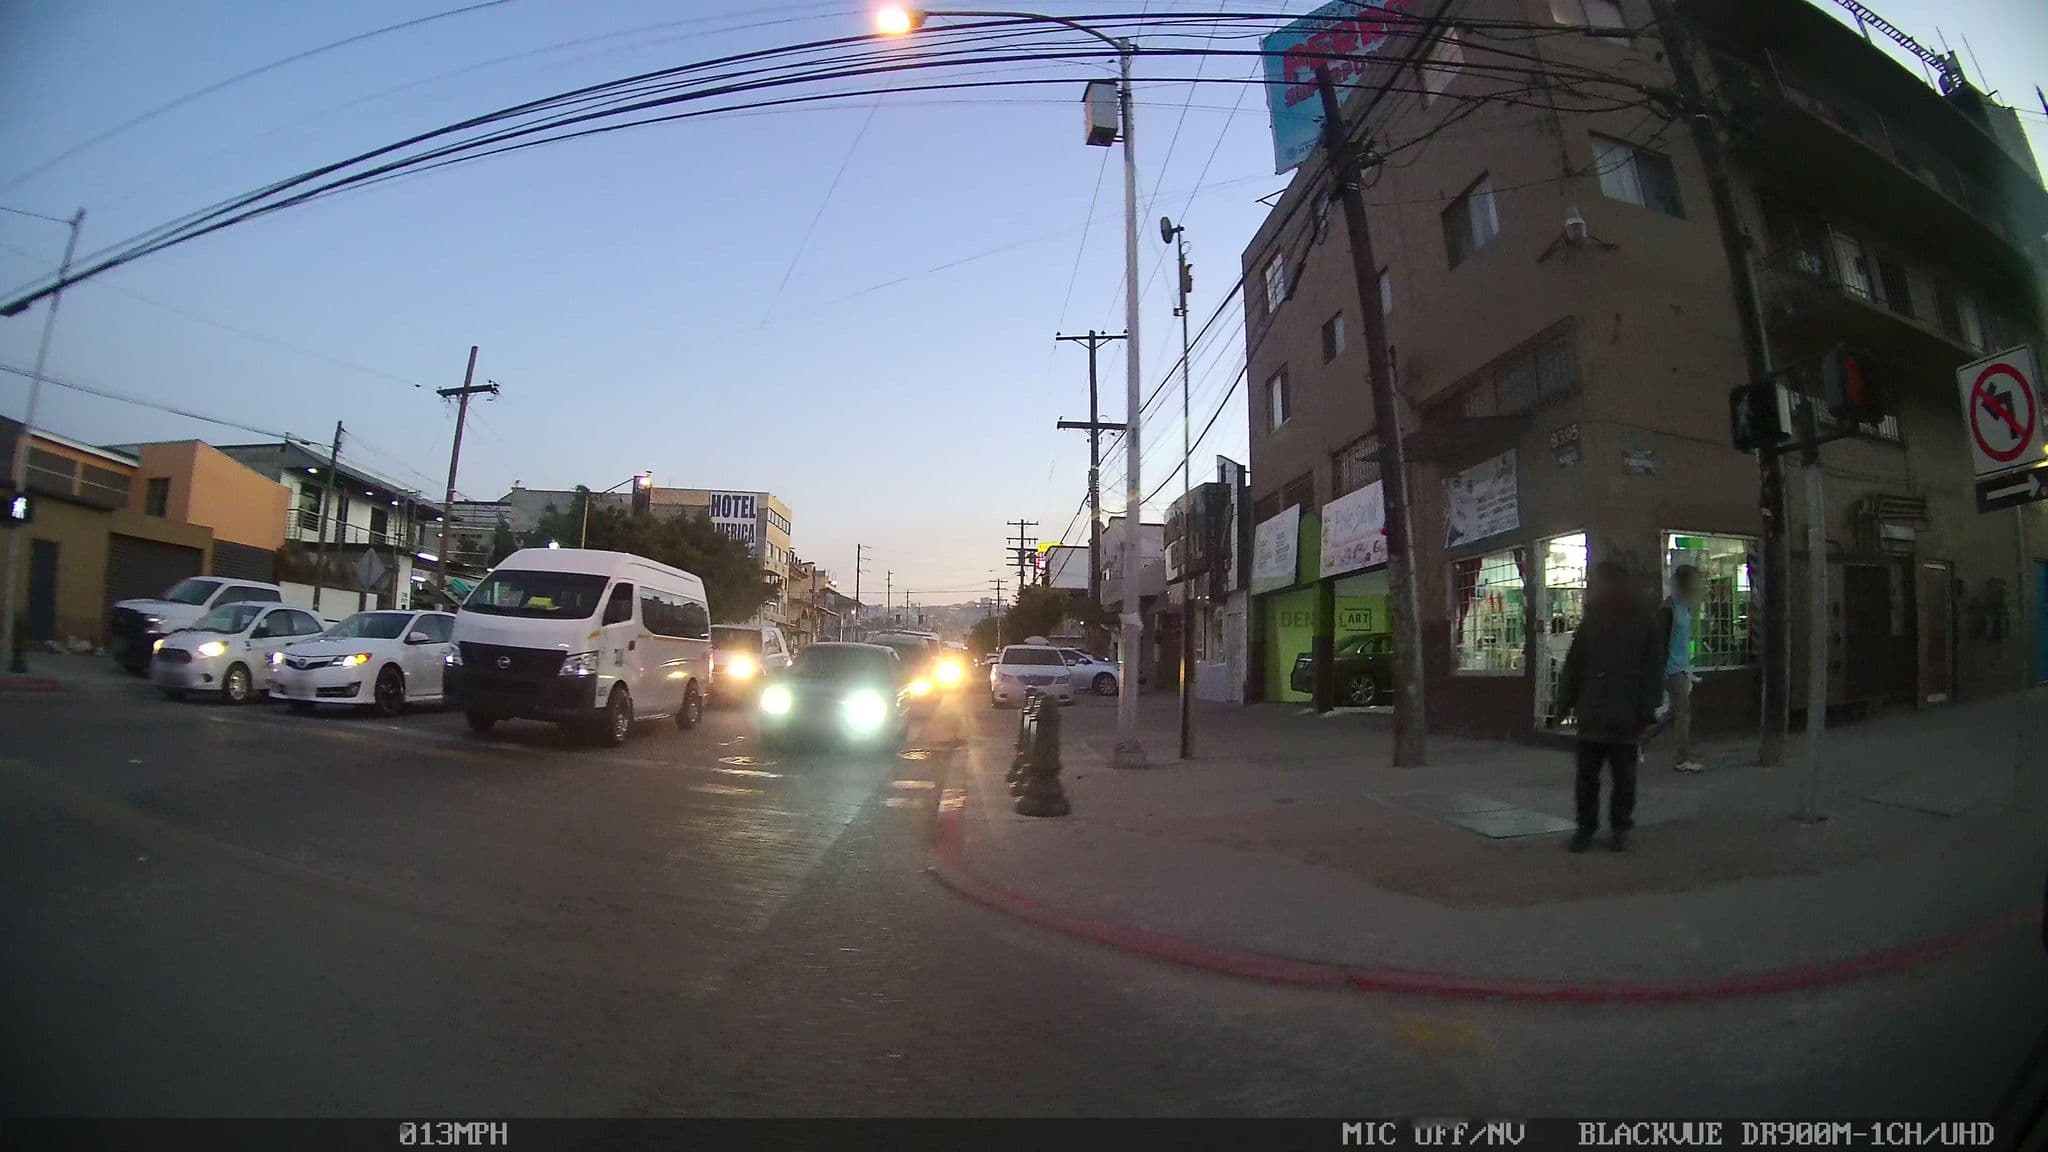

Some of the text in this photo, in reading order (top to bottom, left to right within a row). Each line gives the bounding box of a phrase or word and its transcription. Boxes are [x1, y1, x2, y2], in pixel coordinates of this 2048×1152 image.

[711, 494, 756, 518] HOTEL
[712, 521, 755, 543] MERICA
[1347, 612, 1369, 624] ART
